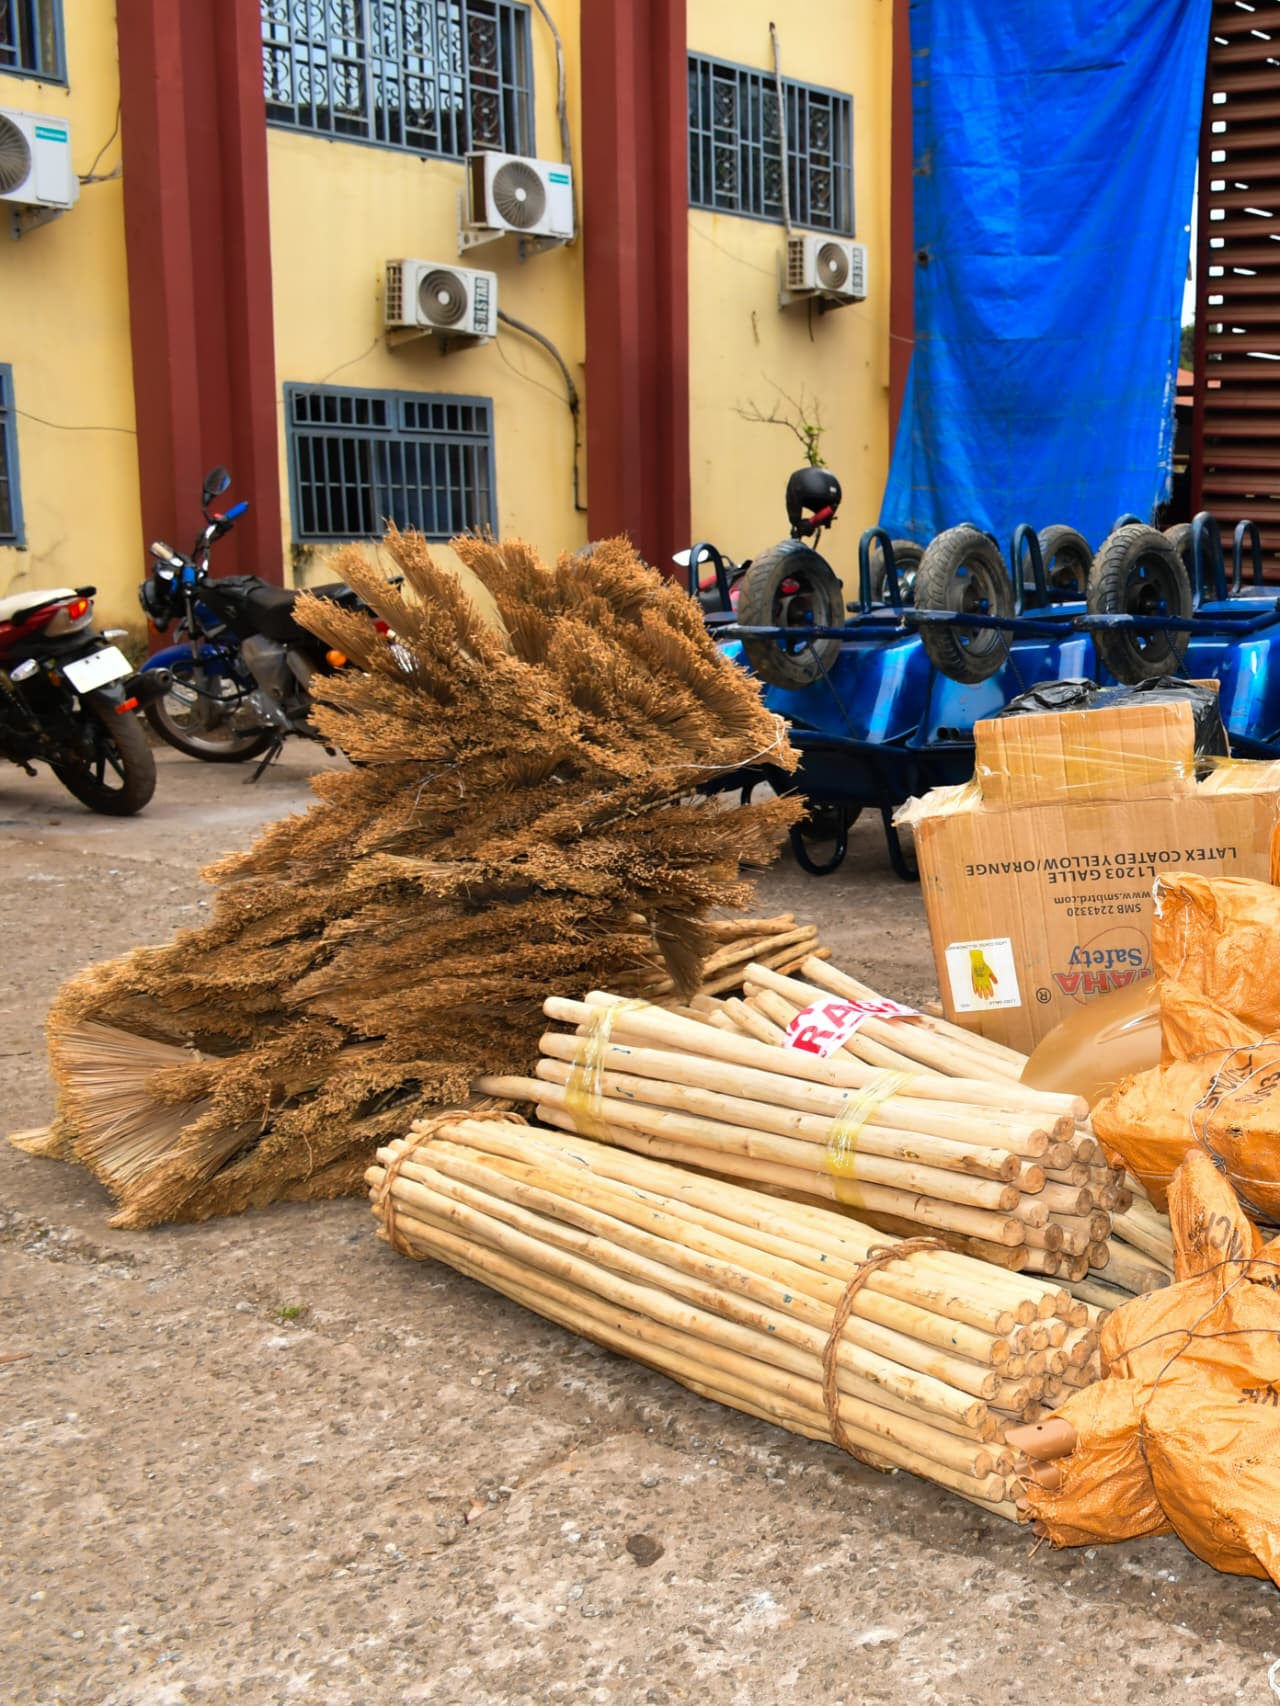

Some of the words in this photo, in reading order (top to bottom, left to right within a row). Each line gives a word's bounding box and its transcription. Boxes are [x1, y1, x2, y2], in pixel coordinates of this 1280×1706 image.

[1114, 850, 1182, 866] COATED
[1185, 846, 1238, 862] LATEX
[964, 852, 1112, 878] YELLOW/ORANGE
[1105, 866, 1156, 880] L1203
[1048, 868, 1101, 885] GALLE
[1053, 890, 1153, 906] www.smbtrd.com
[1066, 904, 1116, 918] 2243320
[1117, 902, 1142, 914] SMB
[1068, 945, 1144, 970] Safety
